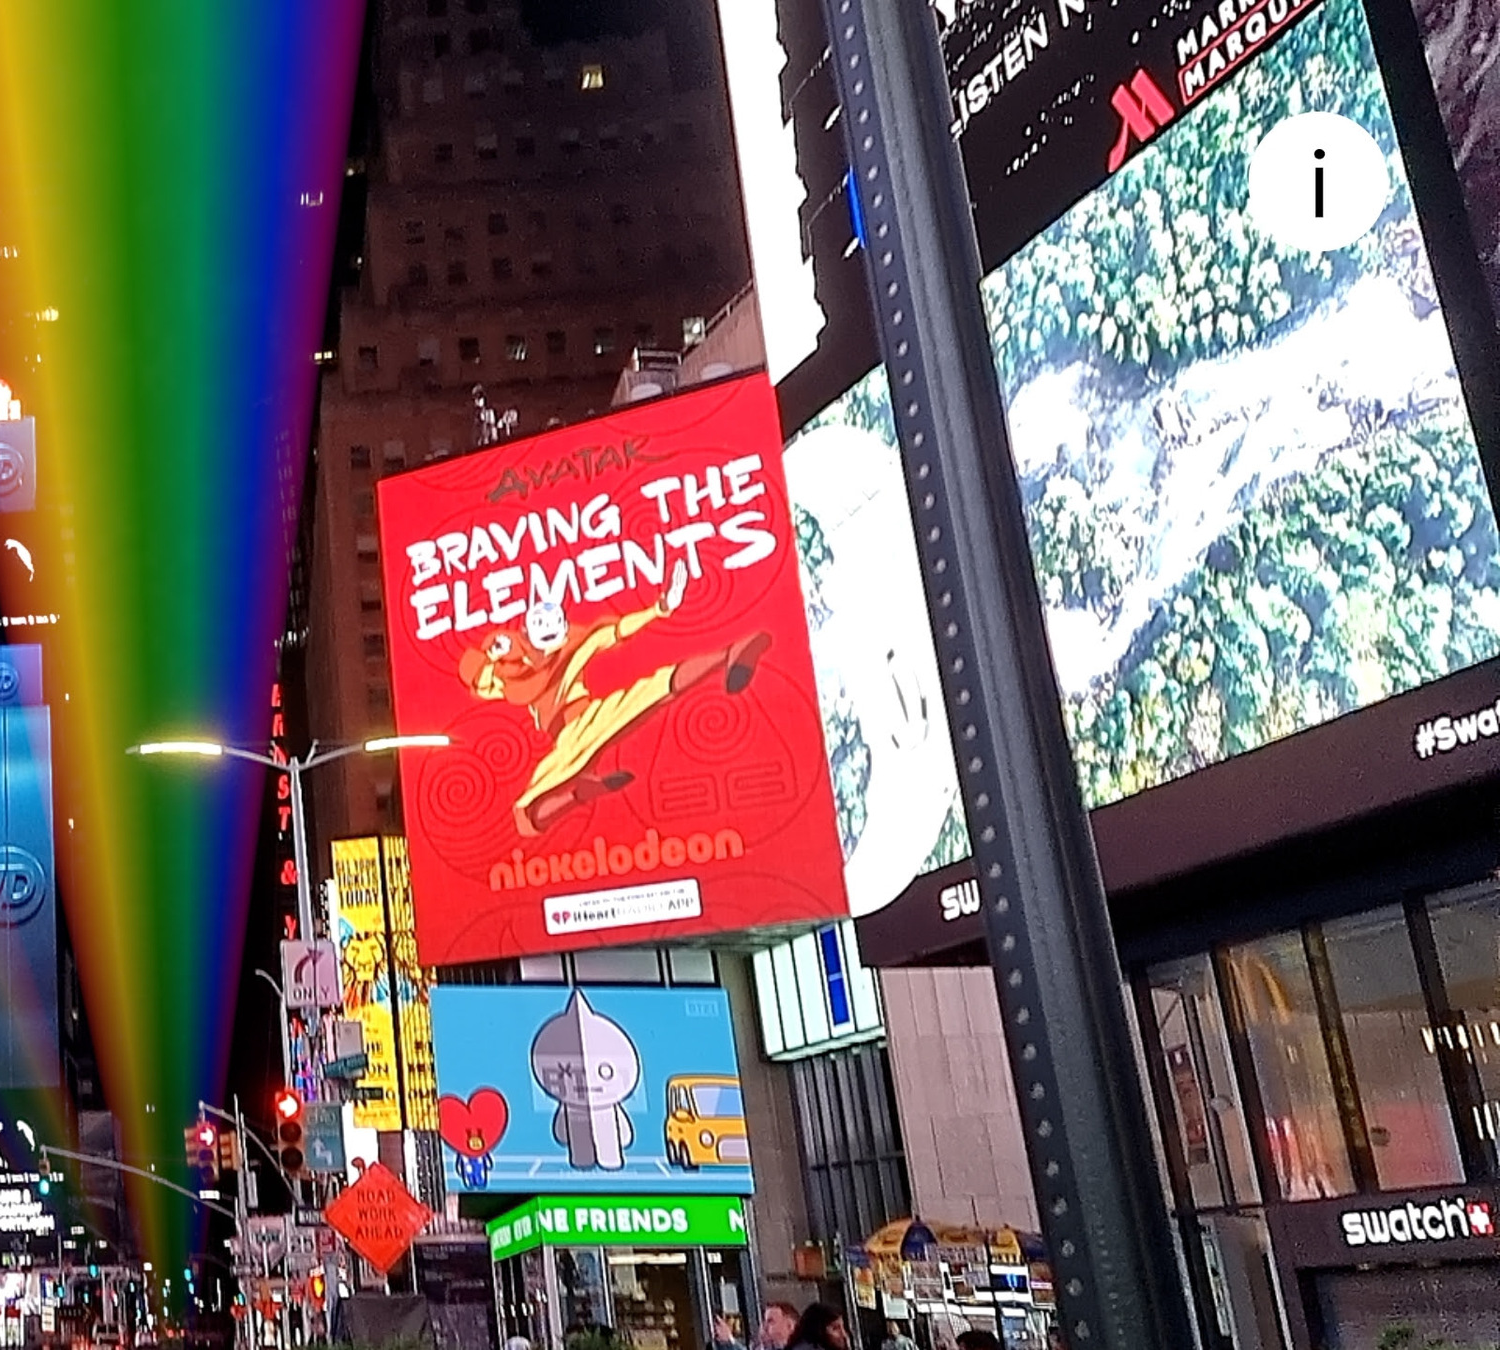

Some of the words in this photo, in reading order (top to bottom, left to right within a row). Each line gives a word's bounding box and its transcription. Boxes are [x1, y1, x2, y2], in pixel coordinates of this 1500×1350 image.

[1184, 0, 1301, 97] MARQU
[487, 436, 673, 502] AVATAR
[407, 494, 620, 585] BRAVING
[641, 454, 767, 525] THE
[410, 511, 778, 642] ELEMENTS
[489, 827, 745, 894] nickelodeon
[293, 985, 330, 1000] ONY
[357, 1188, 395, 1204] ROAD
[358, 1207, 397, 1222] WORK
[574, 1207, 688, 1233] FRIENDS
[355, 1225, 403, 1241] AHEAD
[1342, 1197, 1469, 1246] swatch
